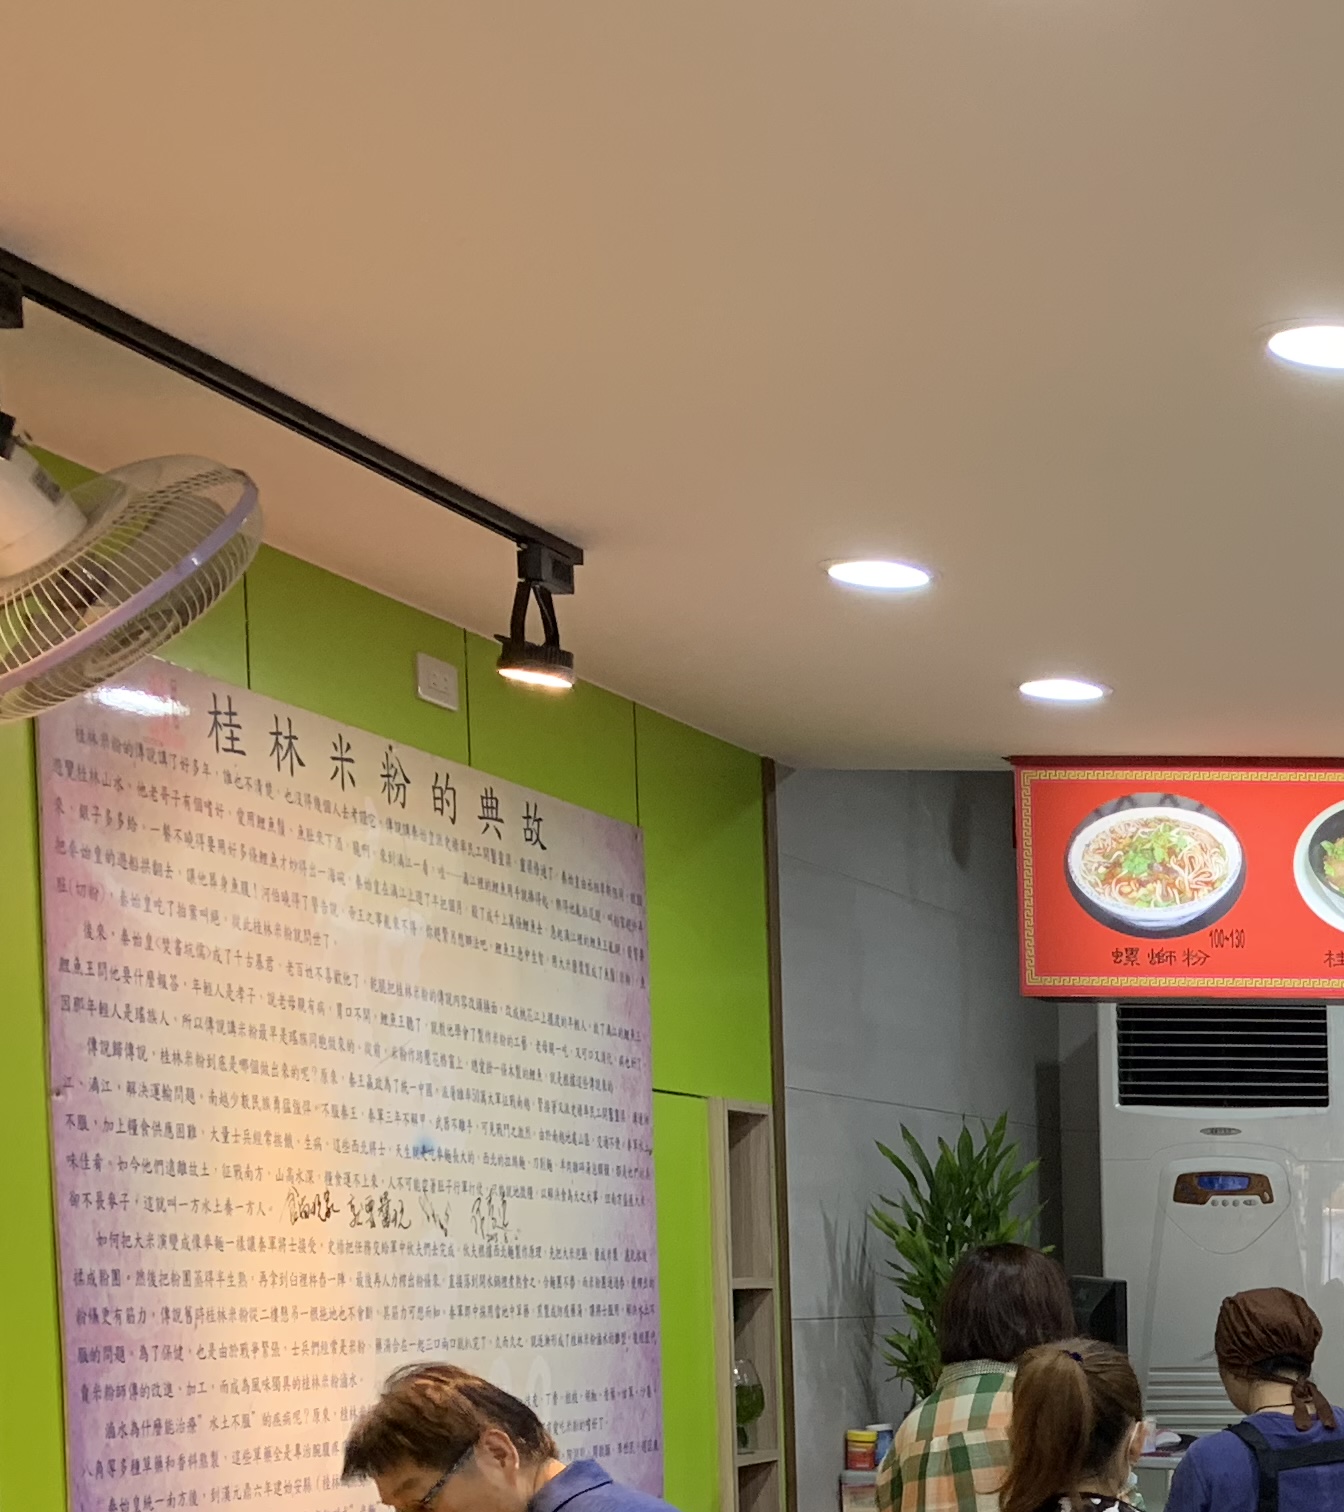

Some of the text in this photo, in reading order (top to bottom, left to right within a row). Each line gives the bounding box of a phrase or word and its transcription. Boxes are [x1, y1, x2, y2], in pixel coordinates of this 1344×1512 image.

[207, 692, 548, 852] 桂林米粉的典故
